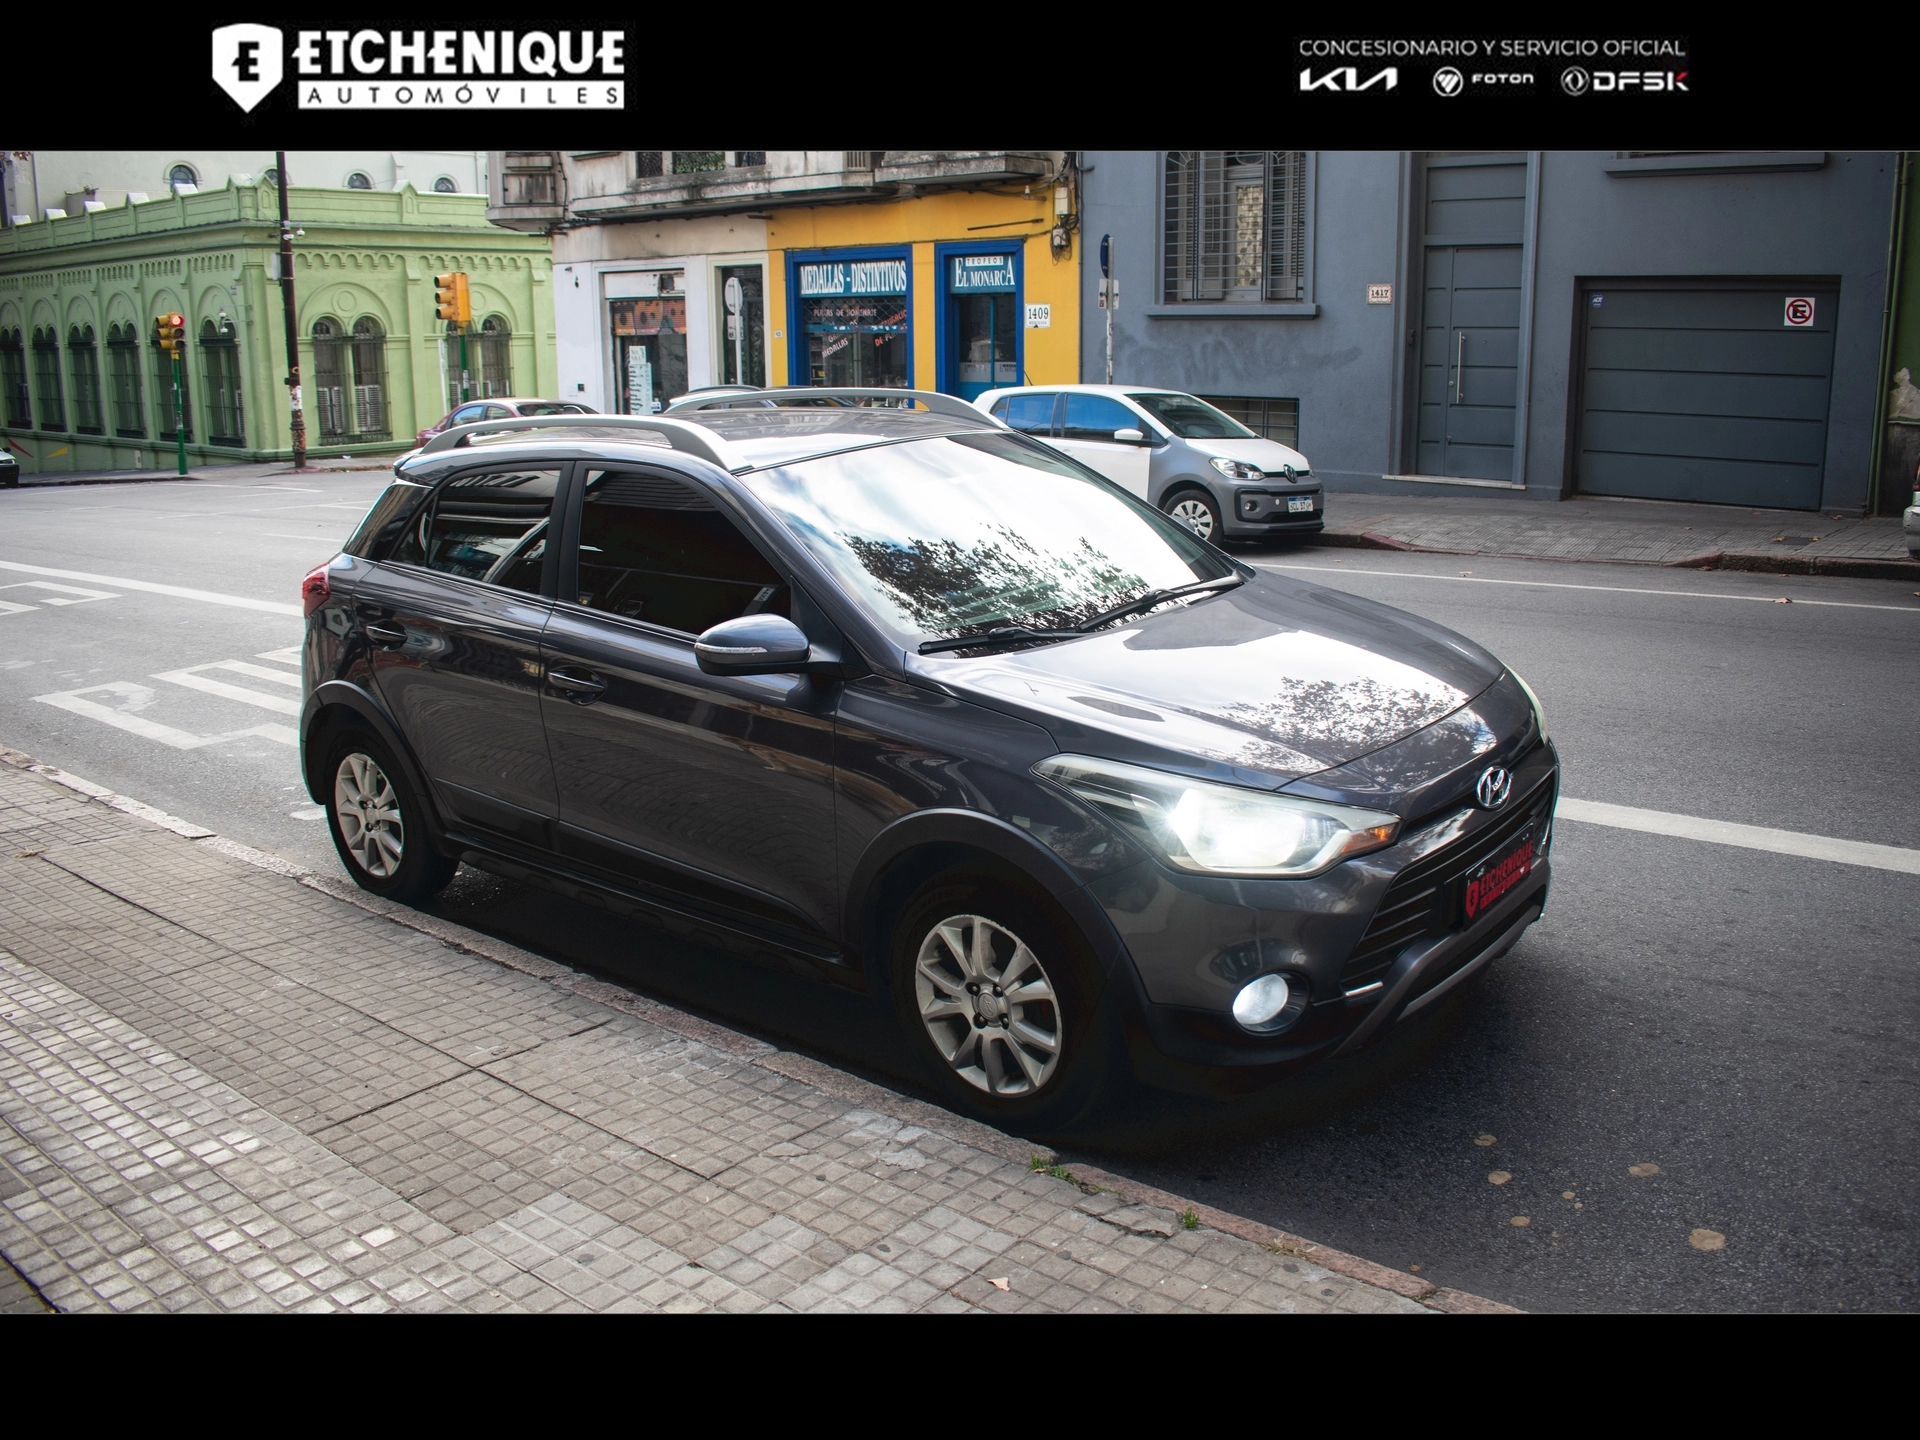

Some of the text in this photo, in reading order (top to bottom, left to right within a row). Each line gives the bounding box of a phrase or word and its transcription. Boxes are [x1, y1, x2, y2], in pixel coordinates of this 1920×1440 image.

[967, 257, 1003, 265] TROFEOS
[970, 256, 1015, 286] MONARCA
[800, 263, 844, 294] MEDALLAS
[851, 260, 907, 293] DISTINTIVOS
[1028, 307, 1049, 320] 1409
[821, 337, 849, 358] MEDALLAS
